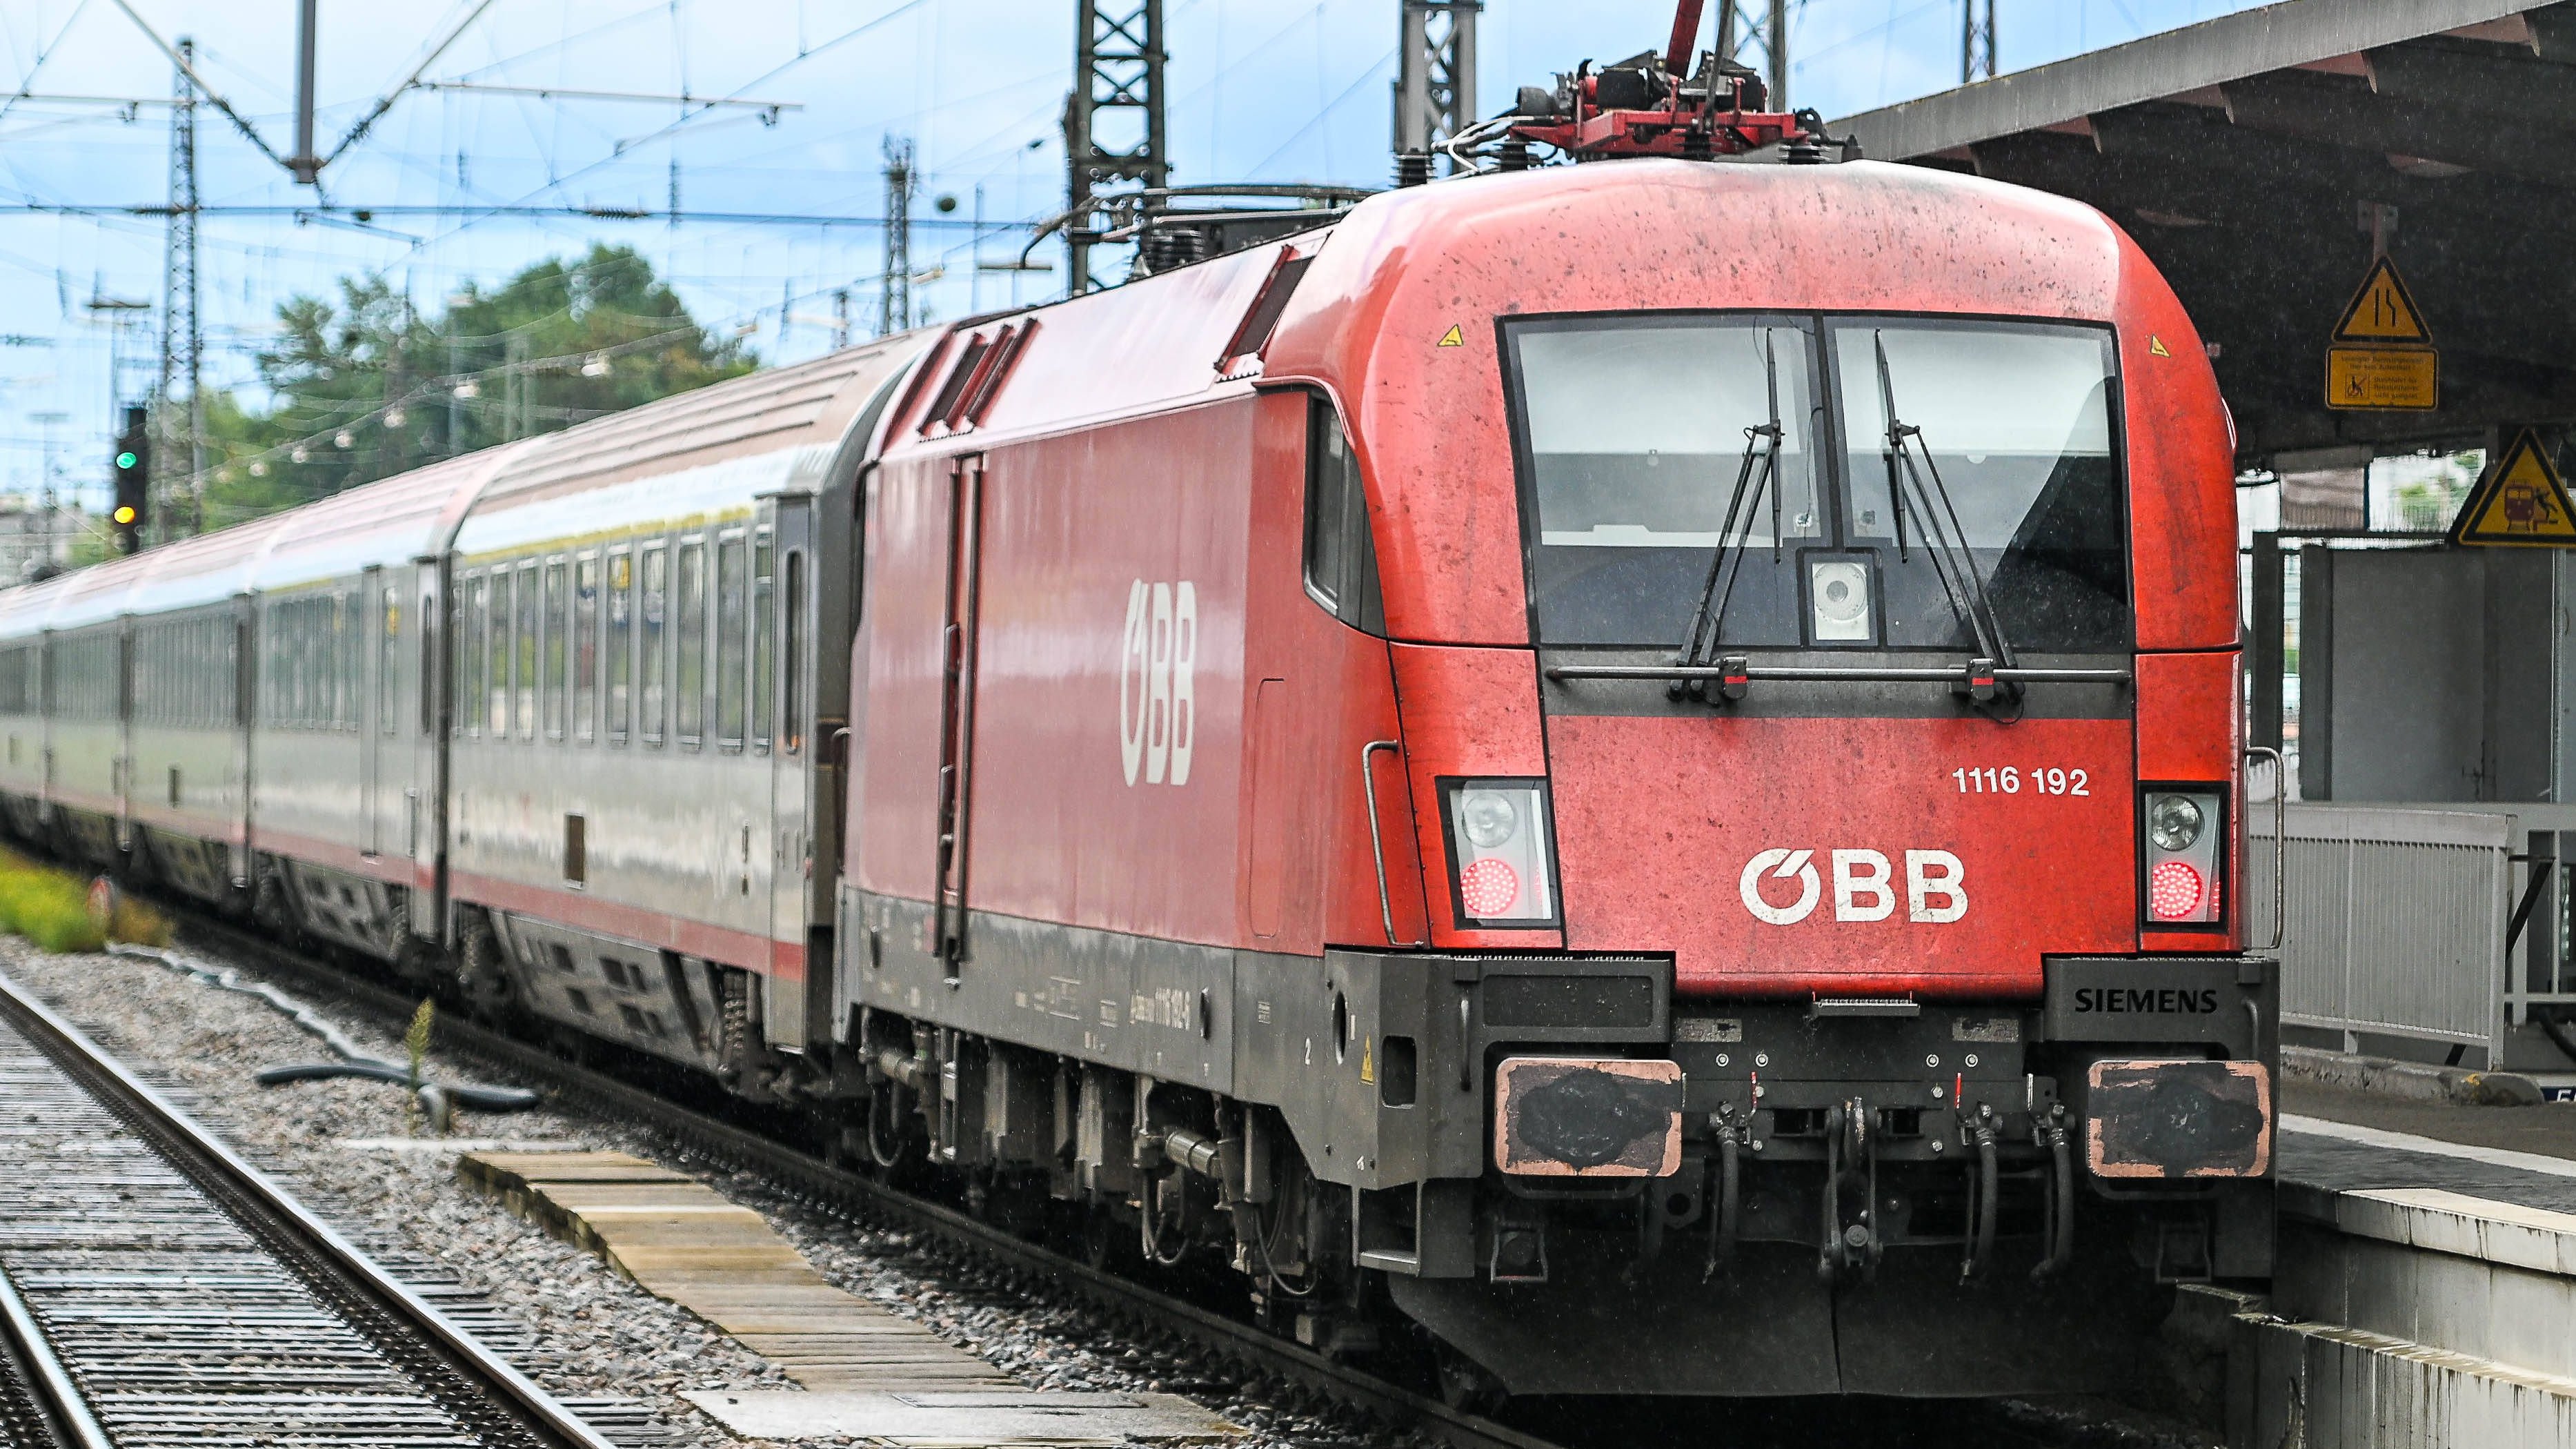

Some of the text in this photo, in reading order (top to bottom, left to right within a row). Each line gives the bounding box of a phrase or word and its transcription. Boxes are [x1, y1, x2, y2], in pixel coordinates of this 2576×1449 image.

[1952, 766, 2090, 796] 1116 192
[2075, 988, 2217, 1014] SIEMENS
[1305, 1036, 1311, 1066] 2
